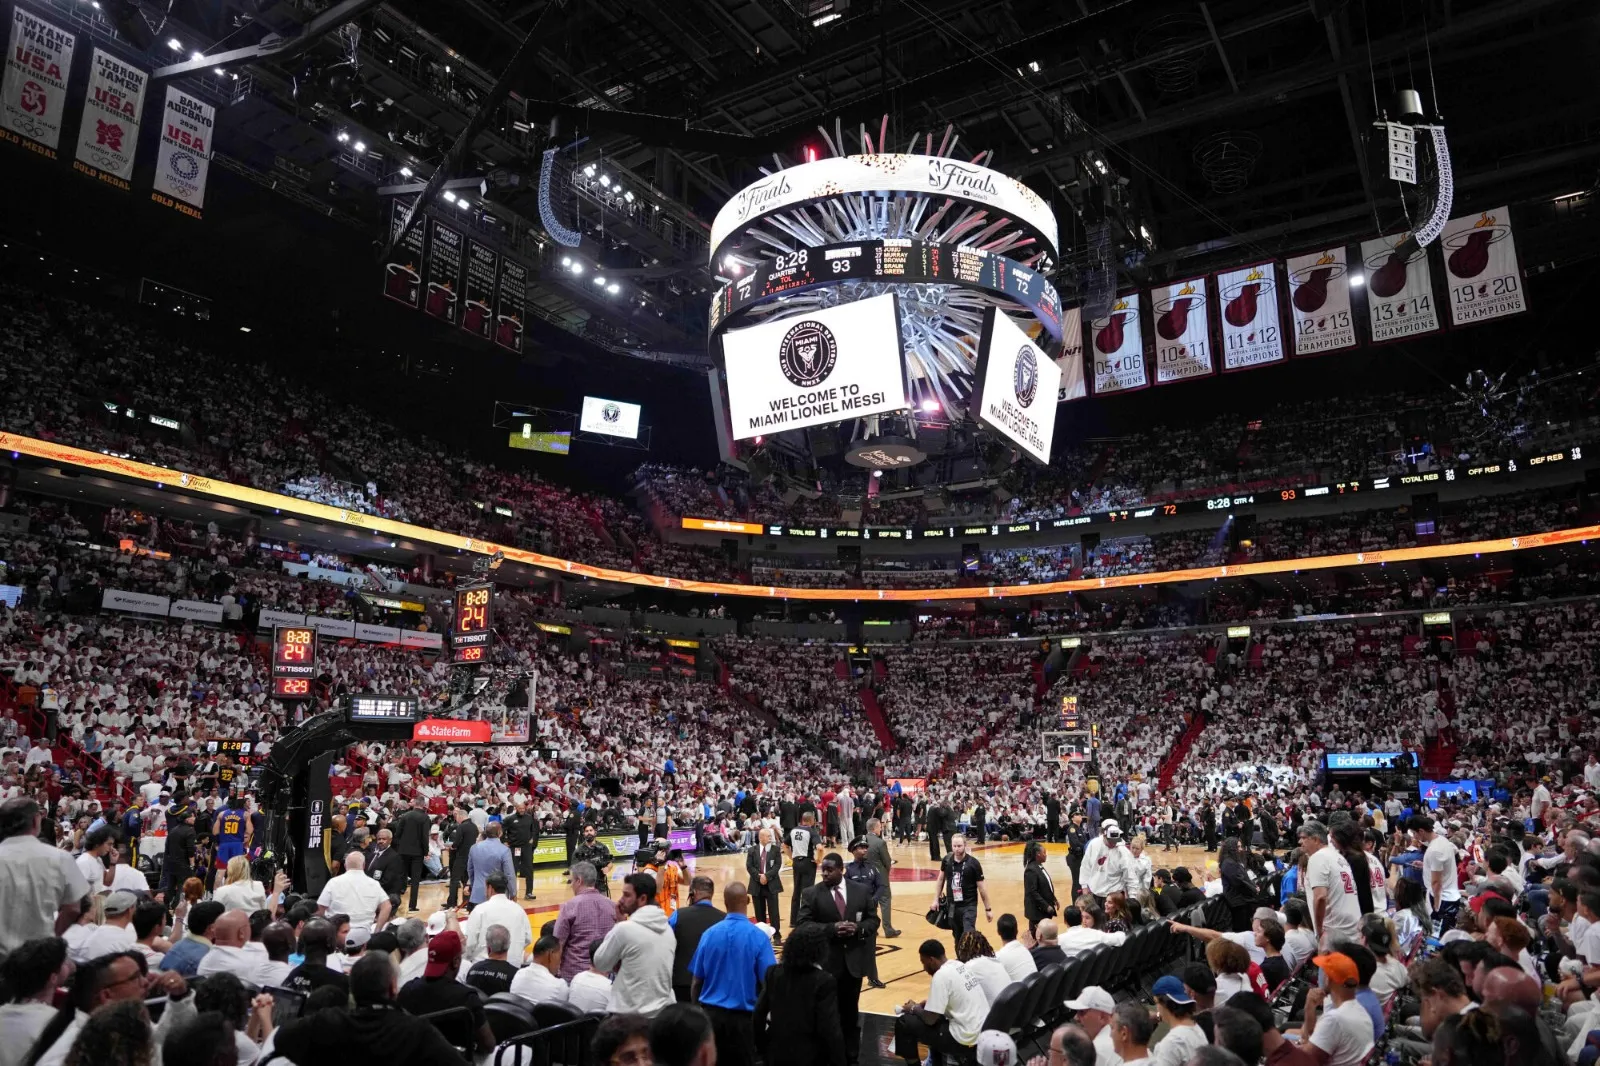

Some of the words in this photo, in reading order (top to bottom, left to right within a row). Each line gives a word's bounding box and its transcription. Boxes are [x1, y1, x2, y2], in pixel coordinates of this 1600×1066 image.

[15, 11, 73, 49] DWYANE
[23, 26, 63, 54] WADE
[15, 46, 63, 80] USA
[96, 55, 143, 85] LEBRON
[98, 68, 139, 94] JAMES
[94, 86, 136, 117] USA
[180, 95, 203, 113] BAM
[166, 100, 213, 128] ADEBAYO
[0, 130, 19, 145] OLD
[22, 138, 58, 161] MEDAL
[167, 124, 204, 152] USA
[73, 160, 97, 178] GOLD
[99, 172, 131, 190] MEDAL
[938, 163, 998, 196] Finals
[738, 175, 792, 220] Finals
[151, 192, 174, 208] GOLD
[176, 200, 202, 220] MEDAL
[776, 249, 808, 270] 8:28
[832, 260, 850, 273] 93
[960, 263, 981, 272] VINCENT
[769, 268, 797, 280] QUARTER
[960, 269, 979, 277] MARTIN
[960, 274, 979, 282] LOWRY
[739, 286, 750, 300] 72
[1016, 278, 1028, 295] 72
[1454, 285, 1475, 304] 19
[1493, 275, 1518, 293] 20
[1373, 304, 1393, 322] 13
[1410, 296, 1432, 314] 14
[1456, 302, 1482, 310] EASTERN
[1483, 294, 1519, 305] CONFERENCE
[1458, 300, 1521, 321] CHAMPIONS
[1297, 319, 1315, 335] 12
[1332, 312, 1350, 329] 13
[1375, 320, 1398, 329] EASTERN
[1399, 314, 1433, 325] CONFERENCE
[1375, 320, 1435, 338] CHAMPIONS
[781, 322, 823, 356] INTERNACIONAL
[795, 336, 818, 346] MIAMI
[824, 330, 831, 338] DE
[1228, 333, 1244, 350] 11
[1258, 326, 1277, 343] 12
[1161, 346, 1177, 362] 10
[1190, 342, 1206, 358] 11
[1298, 336, 1353, 352] CHAMPIONS
[1096, 360, 1113, 375] 05
[1124, 354, 1141, 371] 06
[1228, 350, 1280, 366] CHAMPIONS
[782, 359, 791, 377] CLUB
[1160, 364, 1209, 378] CHAMPIONS
[1098, 376, 1143, 390] CHAMPIONS
[770, 388, 836, 411] WELCOME
[840, 384, 859, 397] TO
[749, 409, 788, 429] MIAMI
[791, 400, 838, 420] LIONEL
[842, 392, 885, 410] MESSI
[1002, 398, 1030, 429] WELCOME
[1031, 420, 1038, 434] TO
[990, 404, 1008, 426] MIAMI
[1008, 417, 1027, 440] LIONEL
[1029, 432, 1044, 452] MESSI
[1401, 476, 1422, 484] TOTAL
[1484, 466, 1500, 474] REB
[1530, 456, 1546, 465] DEF
[1547, 454, 1563, 462] REB
[187, 476, 212, 490] Finals
[1054, 519, 1074, 527] HUSTLE
[1164, 505, 1176, 515] 72
[1207, 498, 1230, 509] 8:28
[1234, 497, 1247, 505] QTR
[1281, 490, 1296, 500] 93
[345, 510, 364, 524] Finals
[1009, 525, 1030, 533] BLOCKS
[1518, 537, 1540, 548] Finals
[1362, 553, 1382, 562] Finals
[466, 590, 488, 604] 8:28
[462, 608, 484, 631] 24
[287, 630, 310, 644] 8:28
[462, 634, 487, 643] TISSOT
[284, 644, 304, 660] 24
[465, 648, 480, 660] 2:29
[287, 666, 314, 674] TISSOT
[284, 680, 308, 693] 2:29
[1062, 704, 1075, 714] 24
[222, 742, 241, 750] 8:28
[239, 756, 249, 764] 93
[221, 772, 233, 782] 22
[310, 814, 322, 825] GET
[224, 822, 239, 834] 50
[310, 826, 322, 837] THE
[794, 831, 803, 840] 25
[308, 836, 321, 848] APP
